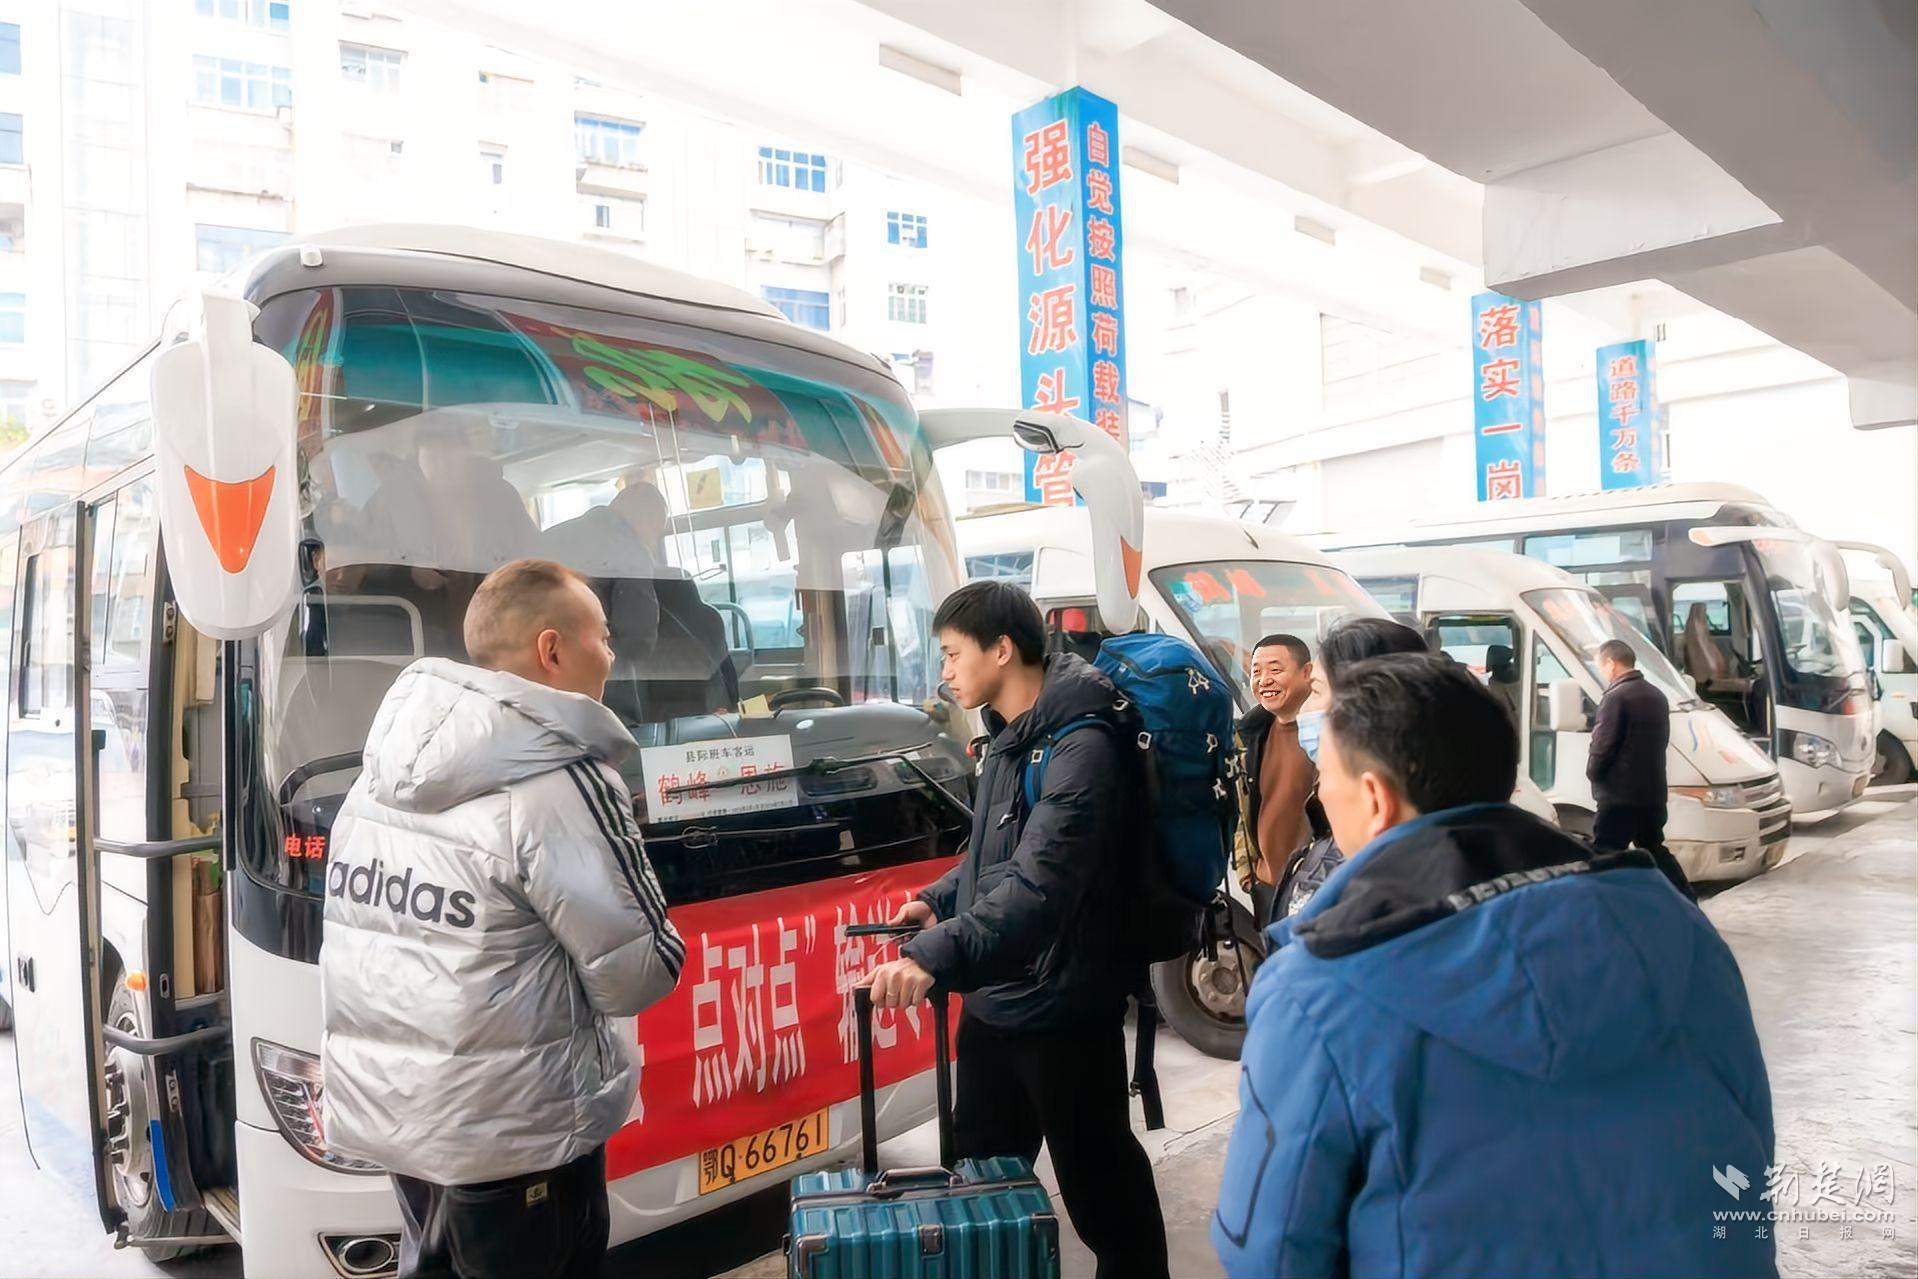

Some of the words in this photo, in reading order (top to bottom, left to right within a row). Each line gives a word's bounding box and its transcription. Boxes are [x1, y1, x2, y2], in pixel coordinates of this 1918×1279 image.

[1479, 304, 1524, 500] 落实一岗
[1609, 354, 1640, 474] 道路千万条
[686, 745, 755, 763] 县际班车客运
[284, 833, 326, 859] 电话
[328, 858, 476, 929] adidas
